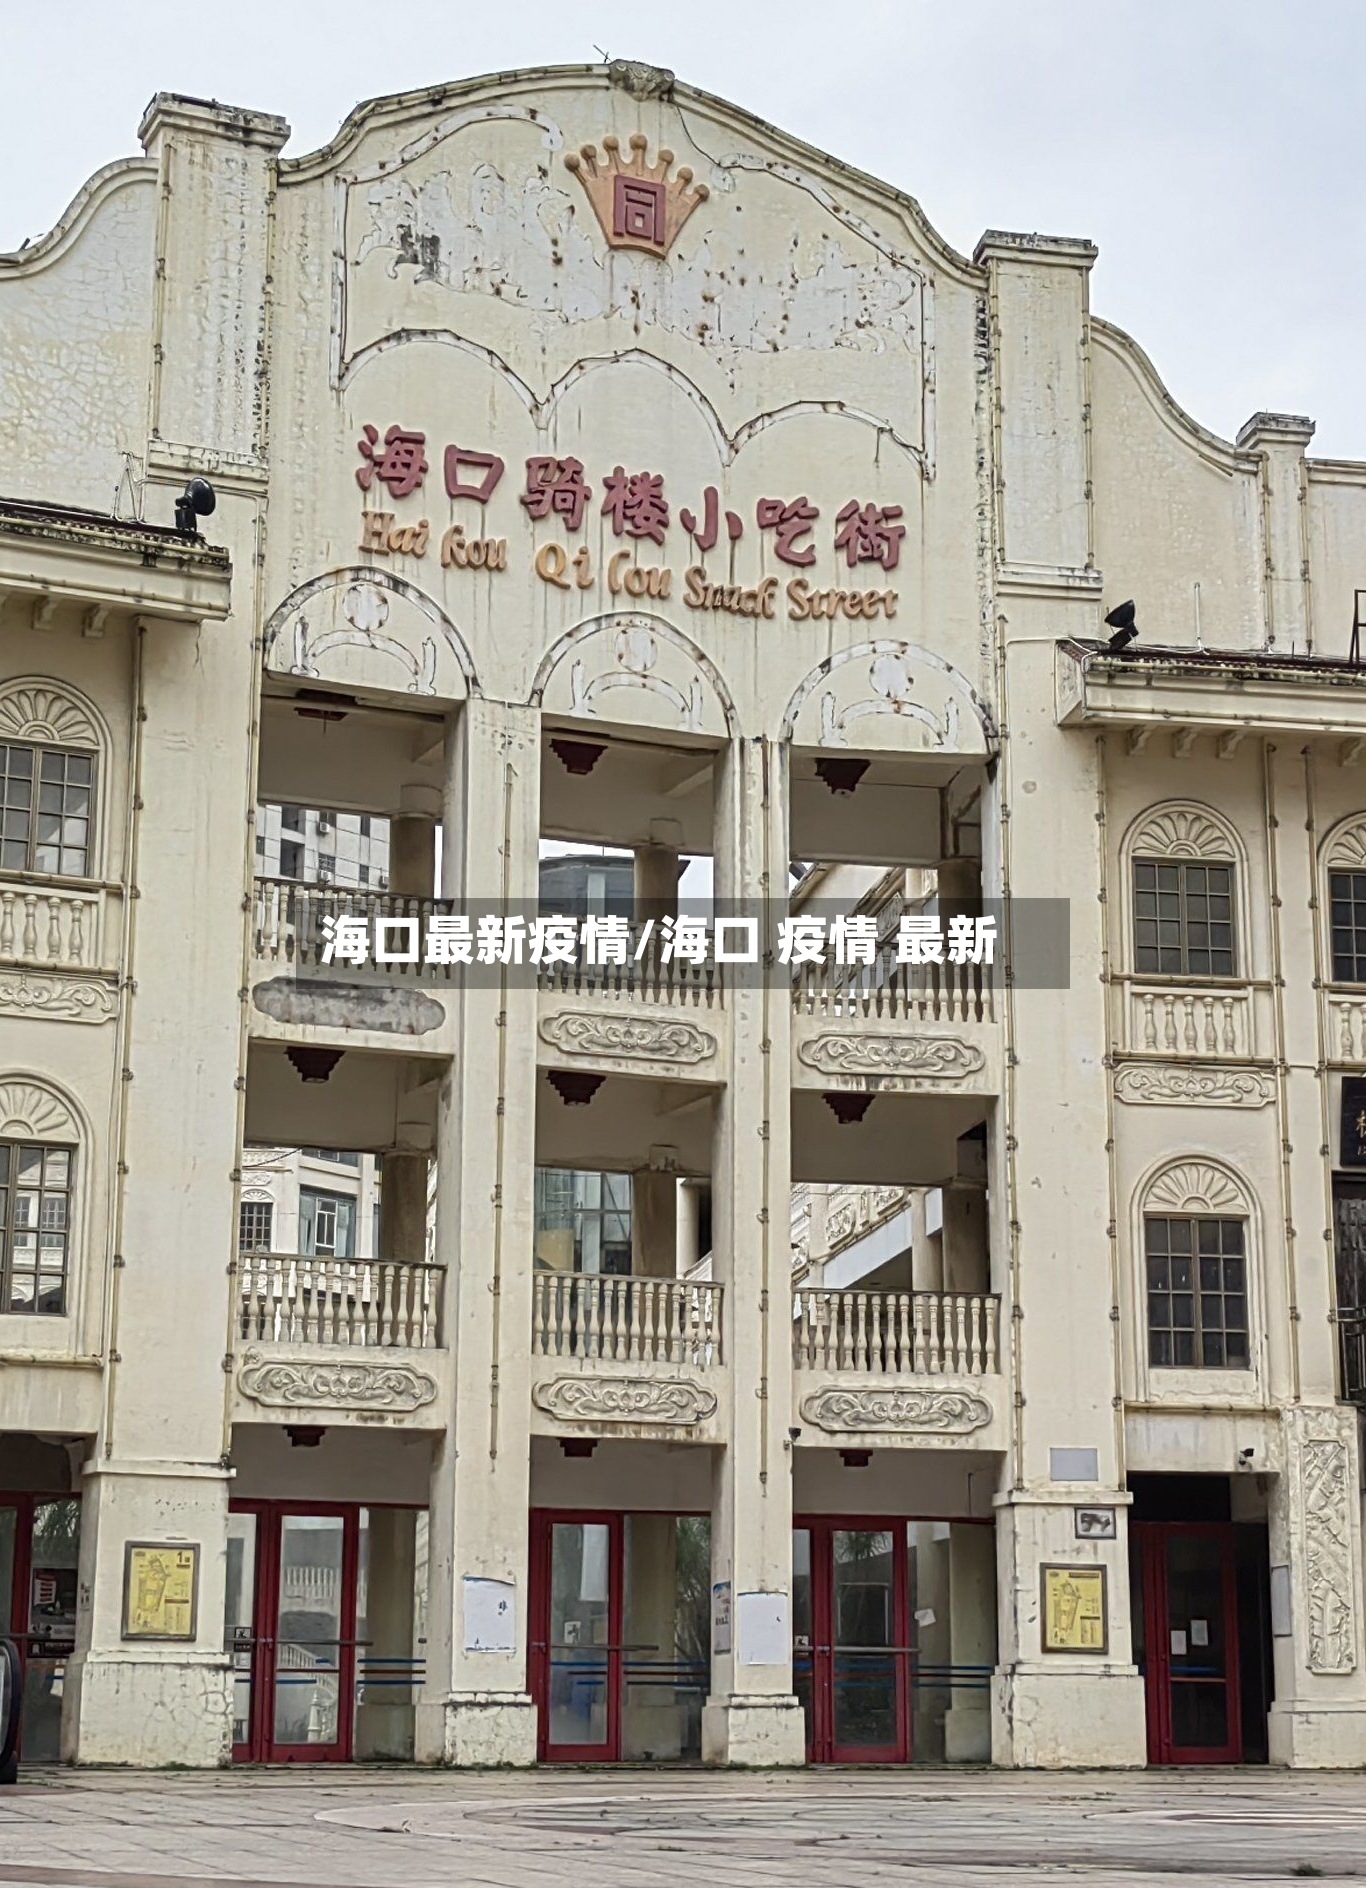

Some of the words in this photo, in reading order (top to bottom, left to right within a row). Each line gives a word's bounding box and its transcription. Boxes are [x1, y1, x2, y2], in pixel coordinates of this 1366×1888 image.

[355, 424, 907, 571] 海口骑楼小吃街
[786, 577, 900, 621] Street
